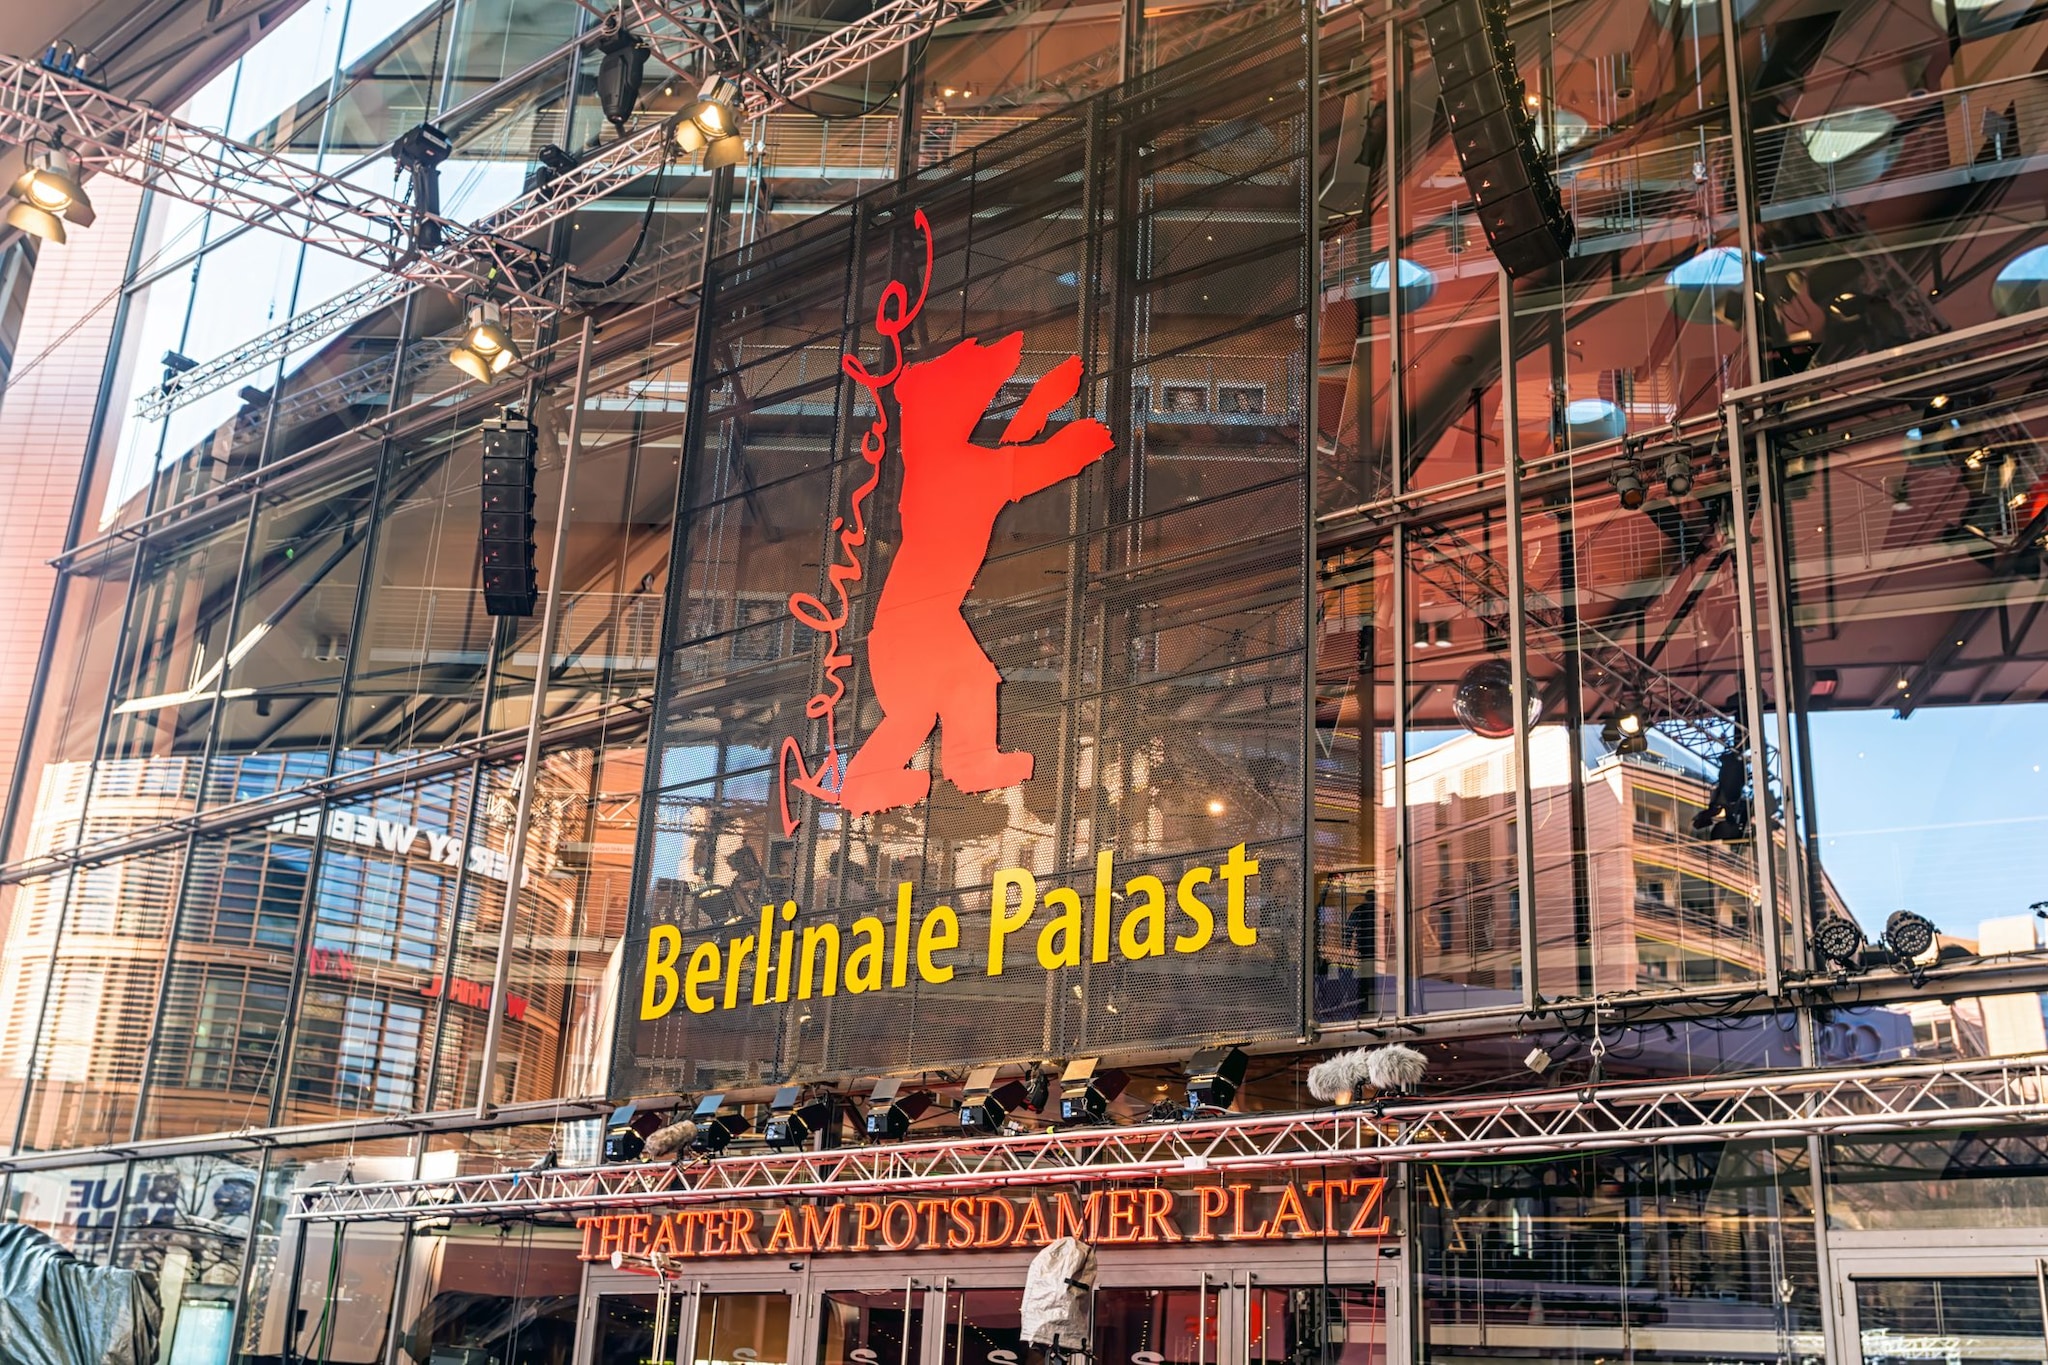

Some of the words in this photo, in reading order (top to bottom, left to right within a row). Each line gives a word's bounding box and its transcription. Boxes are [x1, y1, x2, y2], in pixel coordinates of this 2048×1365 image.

[640, 880, 959, 1021] Berlinale
[987, 843, 1260, 976] Palast
[576, 1208, 758, 1261] THEATER
[765, 1202, 844, 1253] AM
[854, 1188, 1182, 1251] POTSDAMER
[1197, 1179, 1389, 1240] PLATZ
